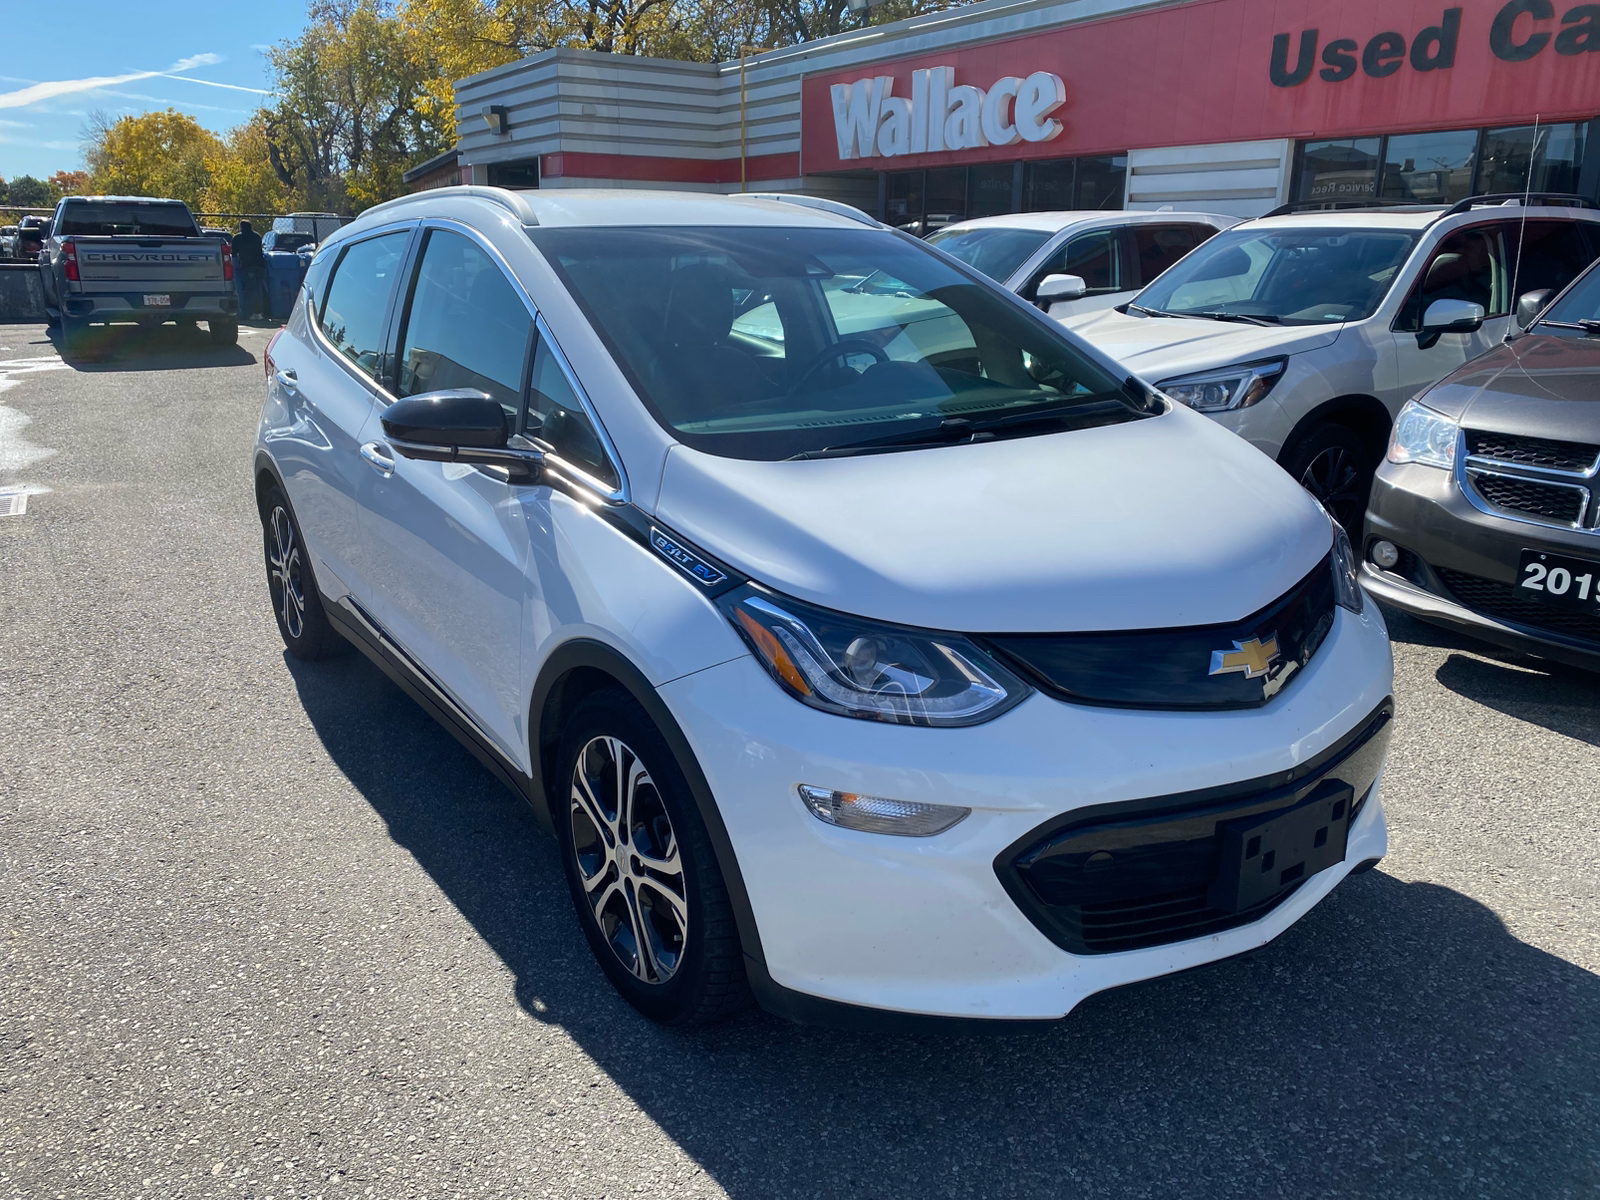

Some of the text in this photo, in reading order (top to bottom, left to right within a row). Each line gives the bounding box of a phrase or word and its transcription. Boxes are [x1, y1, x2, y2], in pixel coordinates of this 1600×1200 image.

[1269, 7, 1463, 88] Used
[830, 66, 1067, 160] Wallace
[87, 253, 213, 262] CHEVROLET
[655, 537, 716, 579] BOLT EV
[1521, 562, 1600, 603] 201
